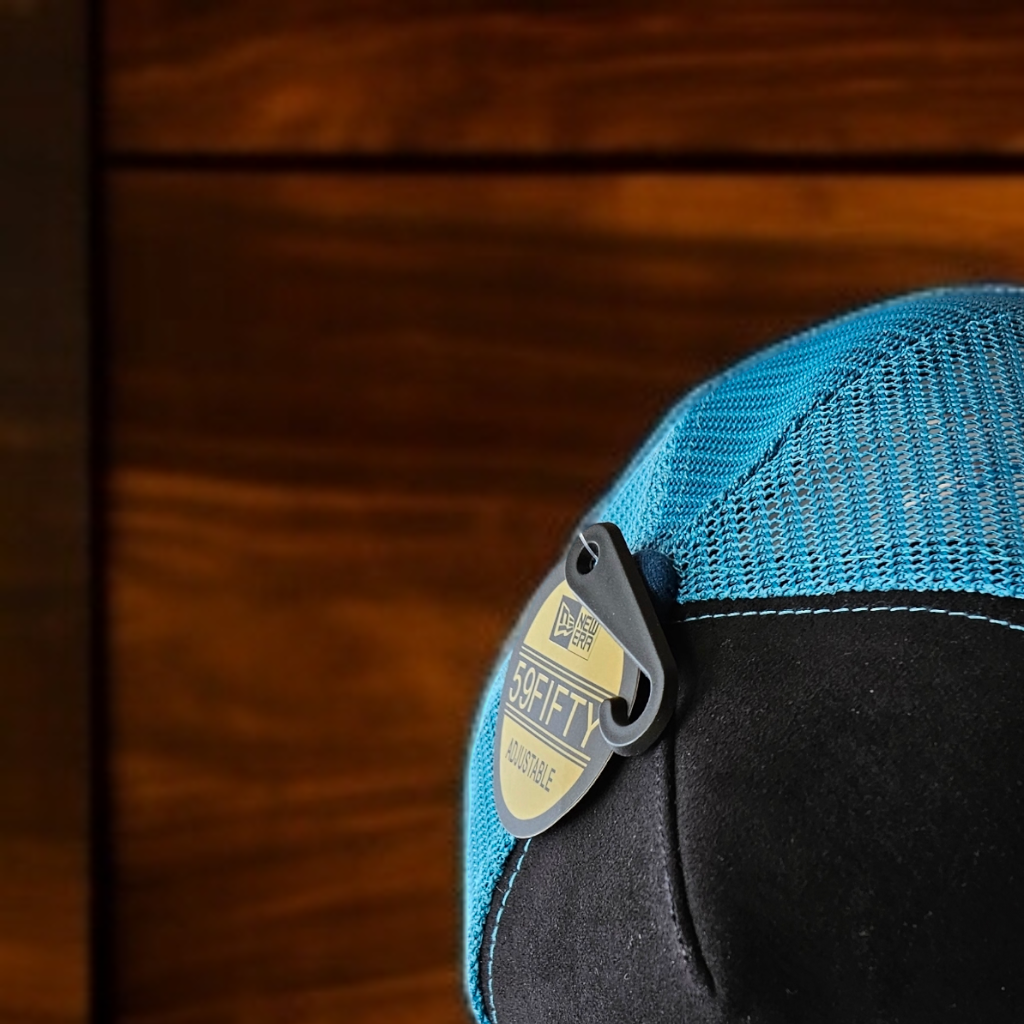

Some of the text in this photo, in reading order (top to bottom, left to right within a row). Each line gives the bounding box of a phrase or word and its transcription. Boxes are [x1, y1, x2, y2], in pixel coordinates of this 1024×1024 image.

[577, 612, 599, 633] NEW
[572, 633, 593, 652] ERA
[509, 660, 600, 748] 59FIFTY
[505, 738, 556, 792] ADJUSTABLE
